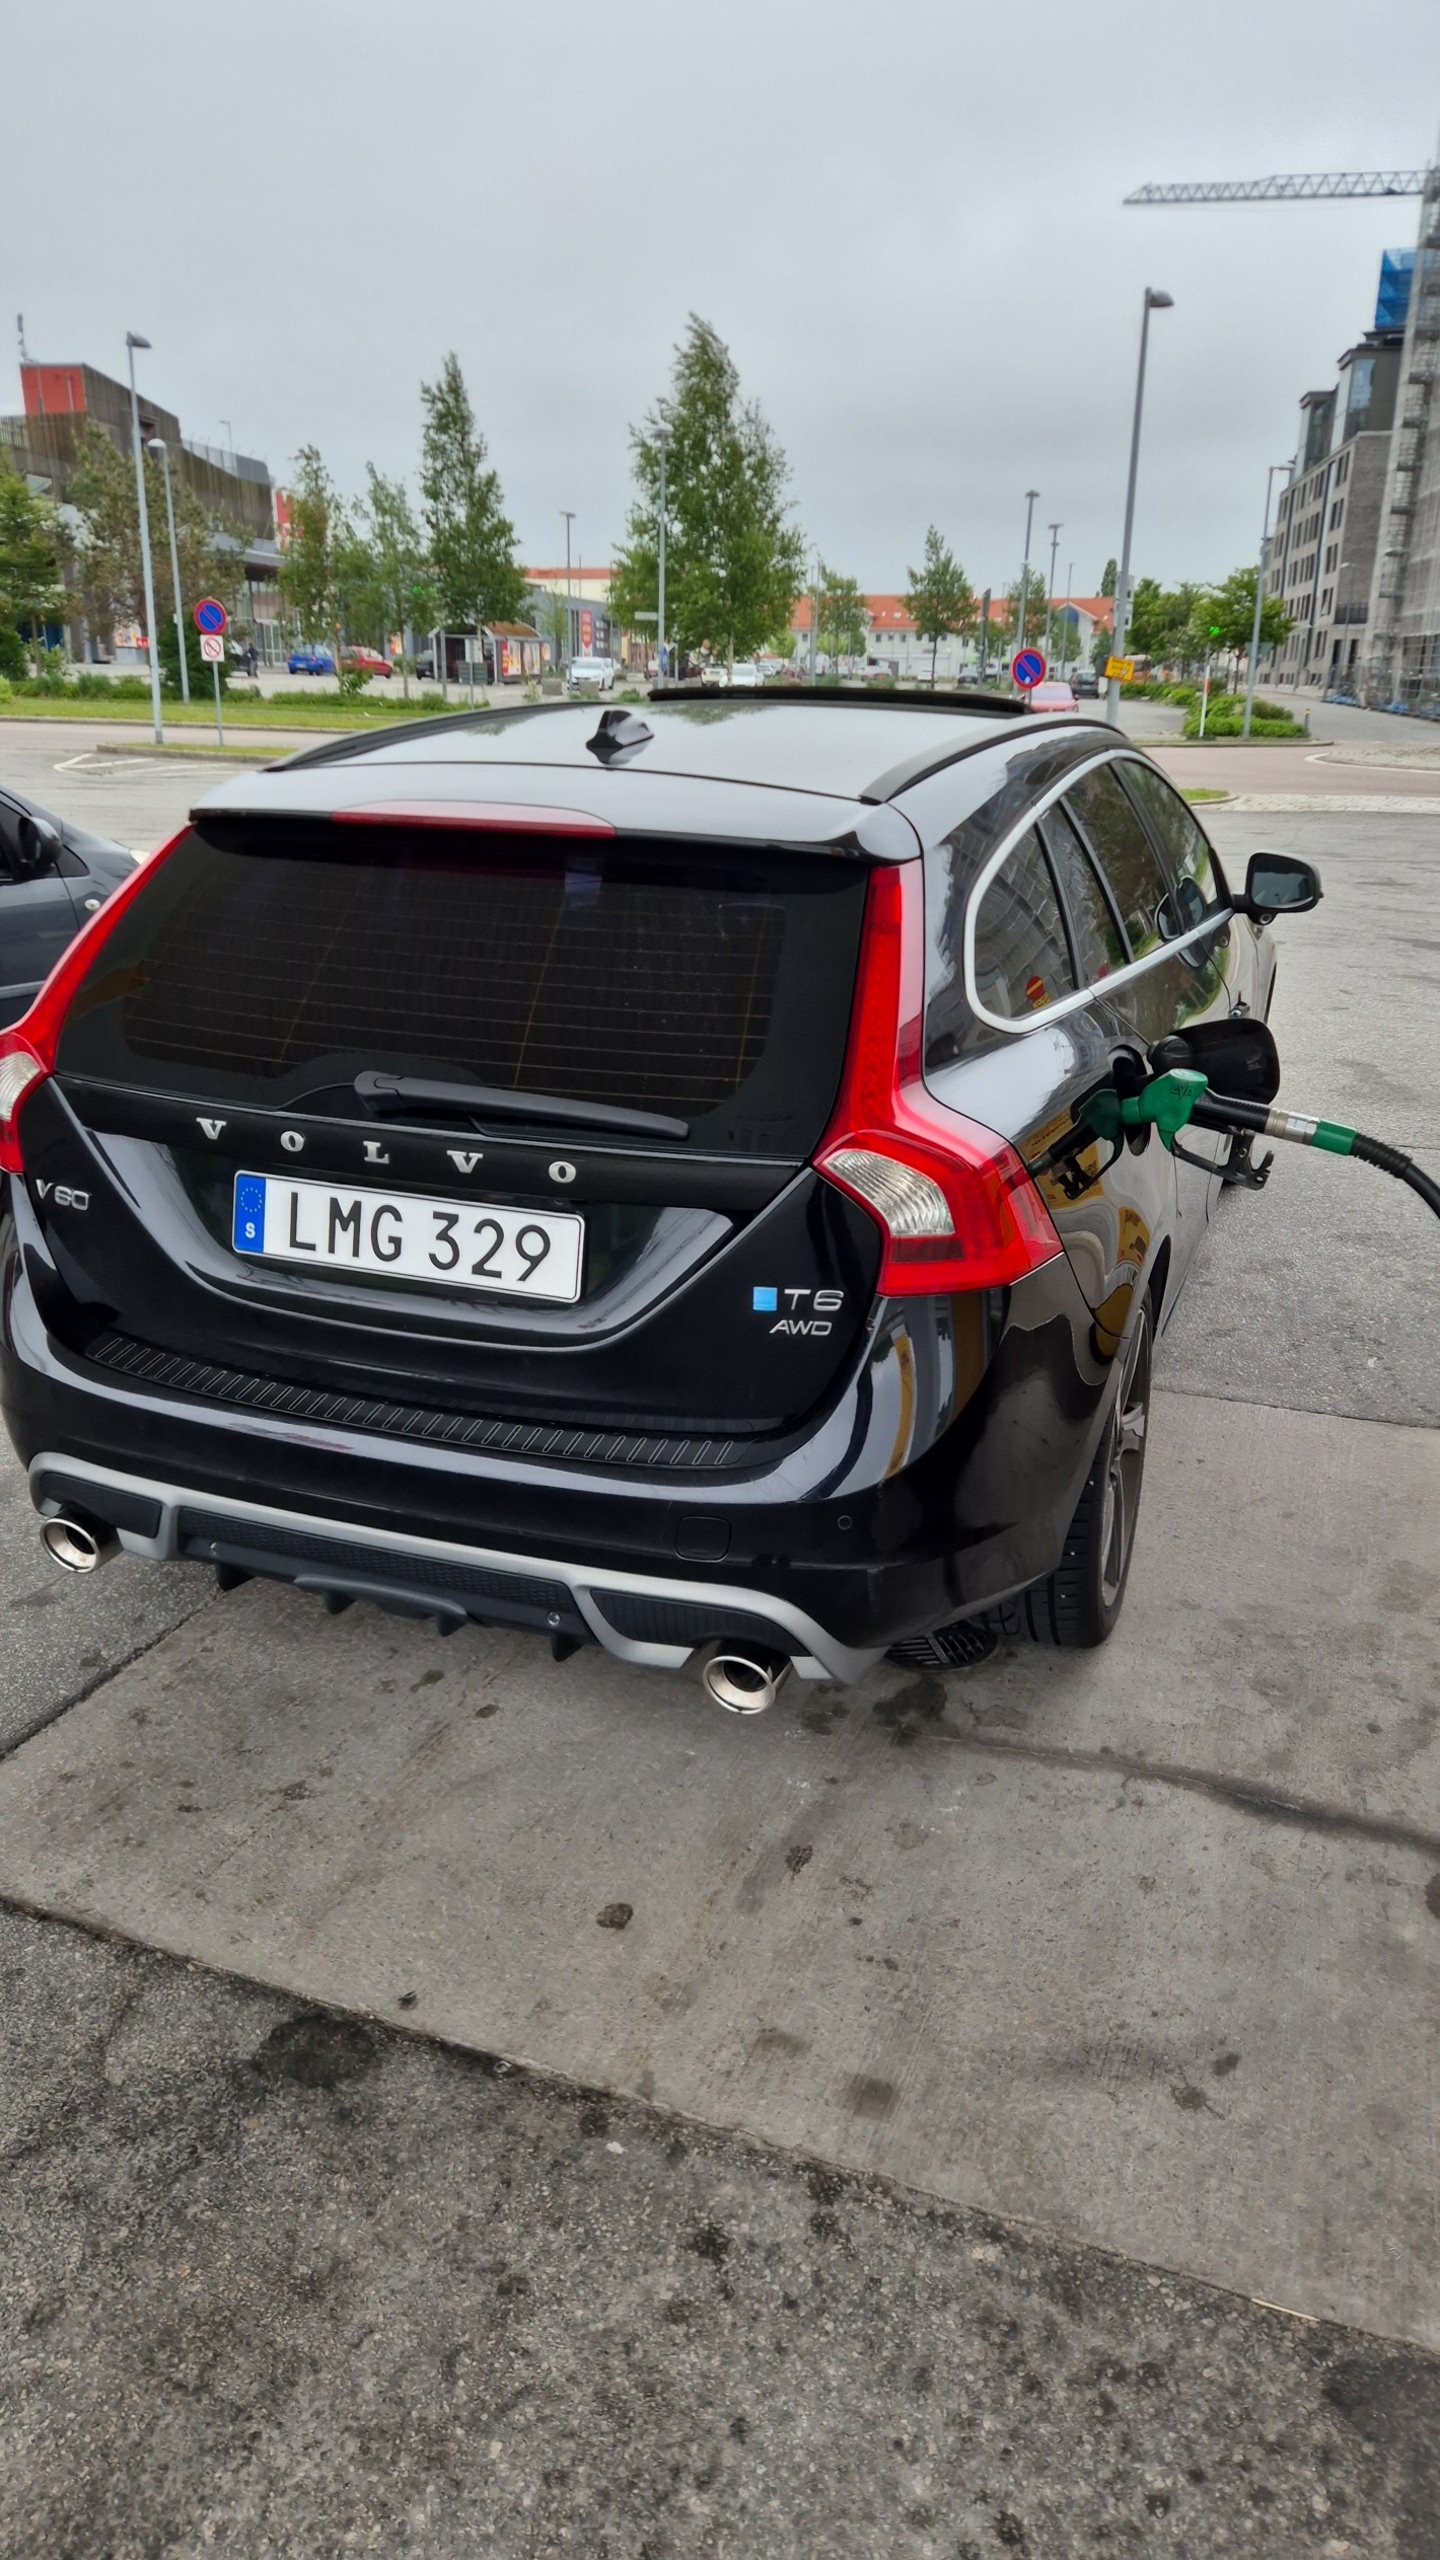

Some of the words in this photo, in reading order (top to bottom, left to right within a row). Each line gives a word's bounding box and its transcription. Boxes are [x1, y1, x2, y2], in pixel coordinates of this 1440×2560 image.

[196, 1117, 577, 1184] VOLVO
[35, 1178, 91, 1211] V60
[244, 1221, 256, 1239] S
[289, 1191, 403, 1262] LMG
[428, 1210, 551, 1282] 329
[783, 1288, 845, 1312] T6
[769, 1319, 833, 1336] AWD
